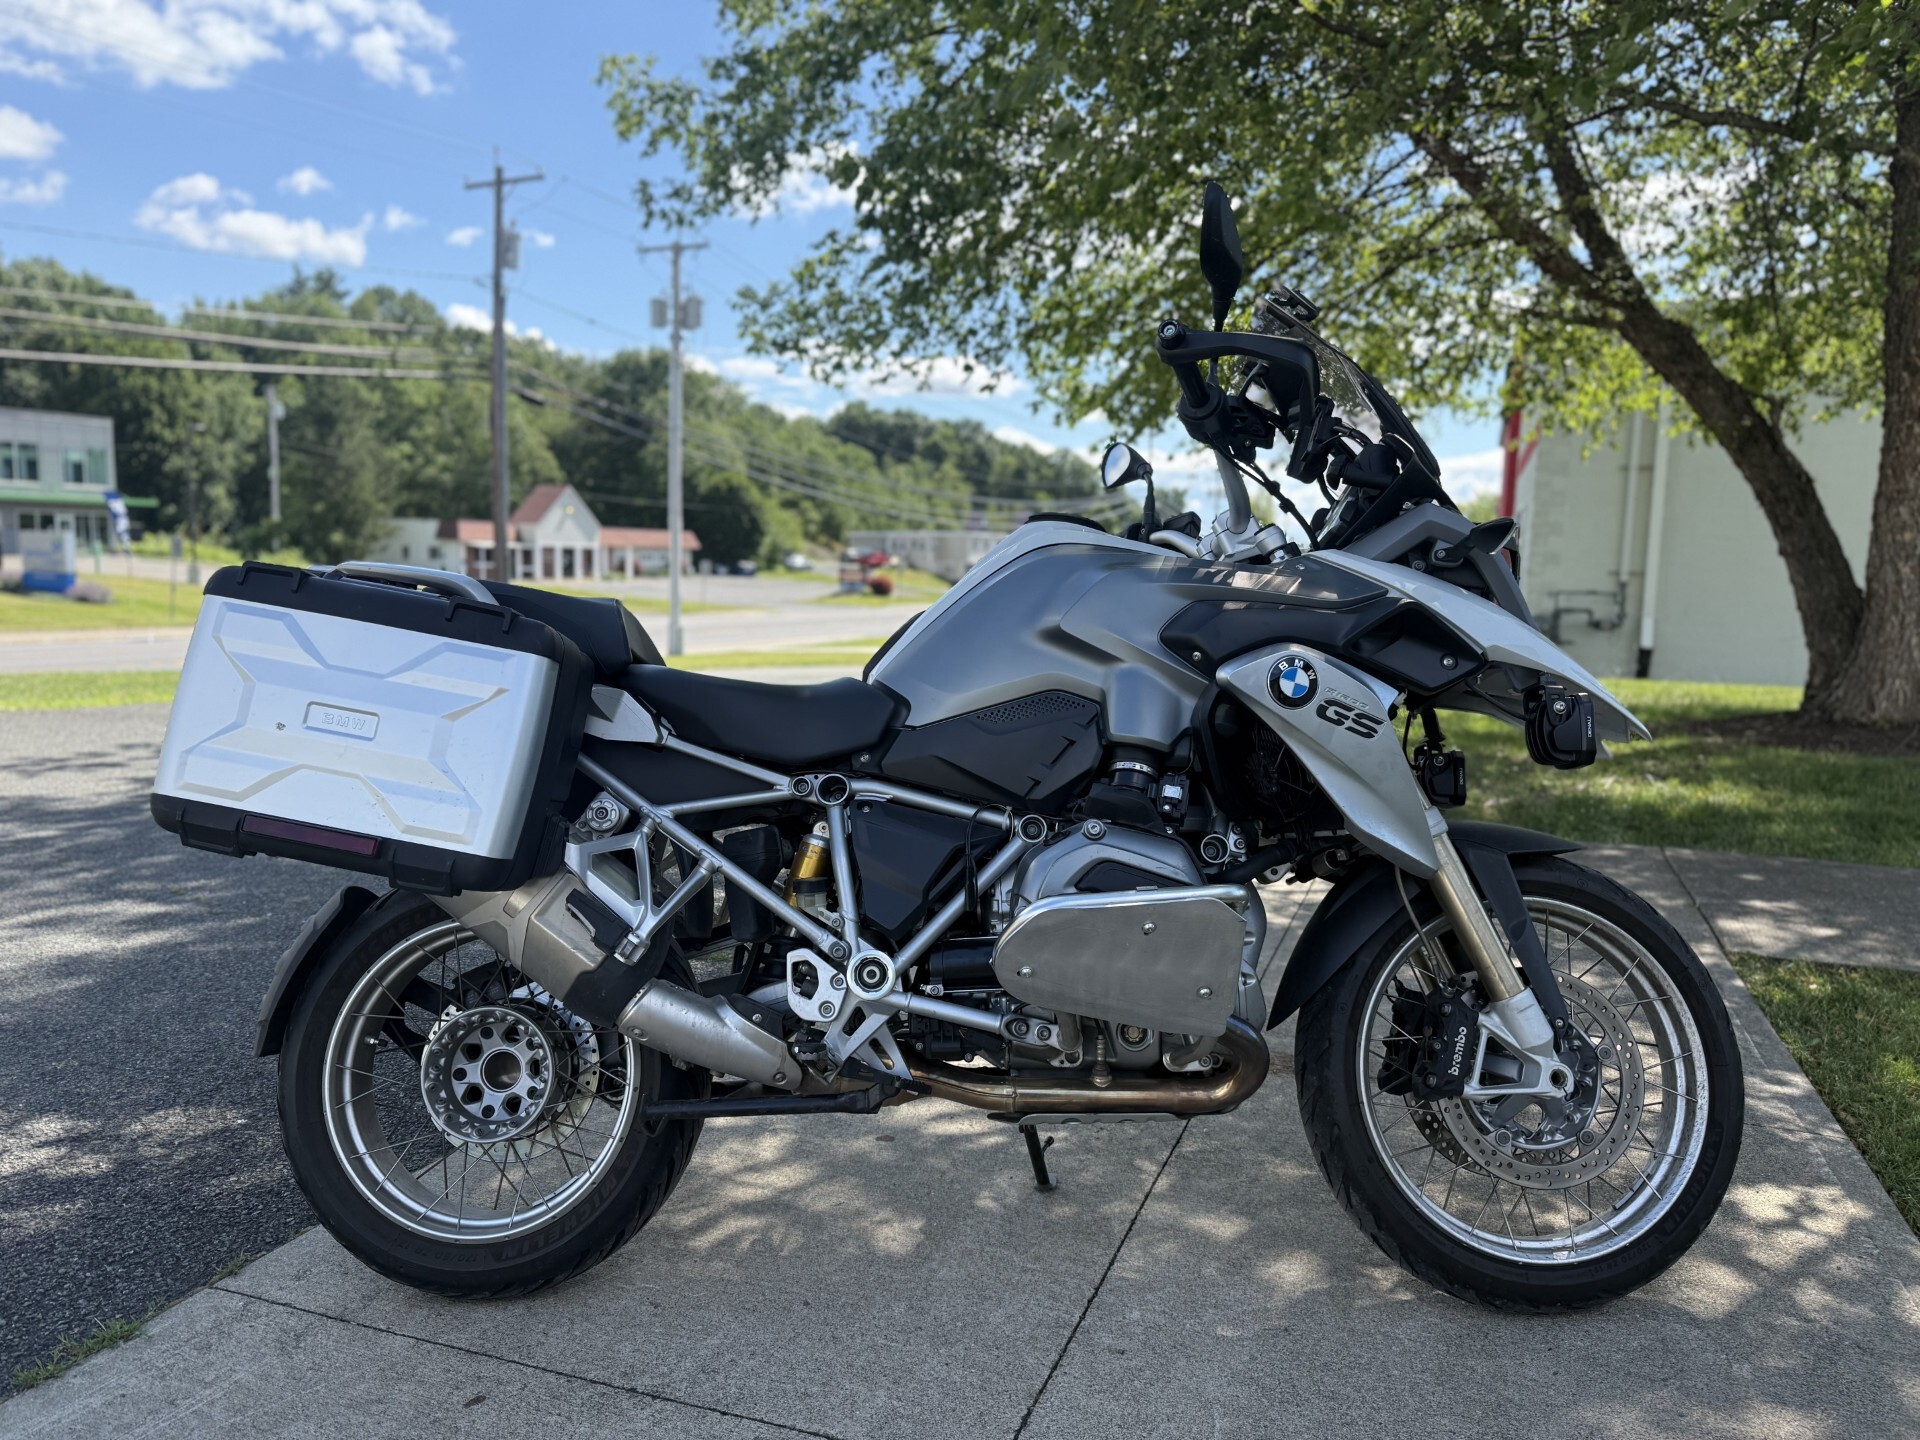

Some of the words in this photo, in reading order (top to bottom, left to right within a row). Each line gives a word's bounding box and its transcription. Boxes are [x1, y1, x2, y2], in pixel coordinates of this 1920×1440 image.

[1278, 659, 1318, 680] BMW
[321, 712, 366, 731] BMW
[1315, 699, 1386, 740] GS
[1447, 1026, 1468, 1076] brembo
[1663, 1147, 1716, 1233] MICHELIN
[501, 1174, 616, 1258] MICHELIN
